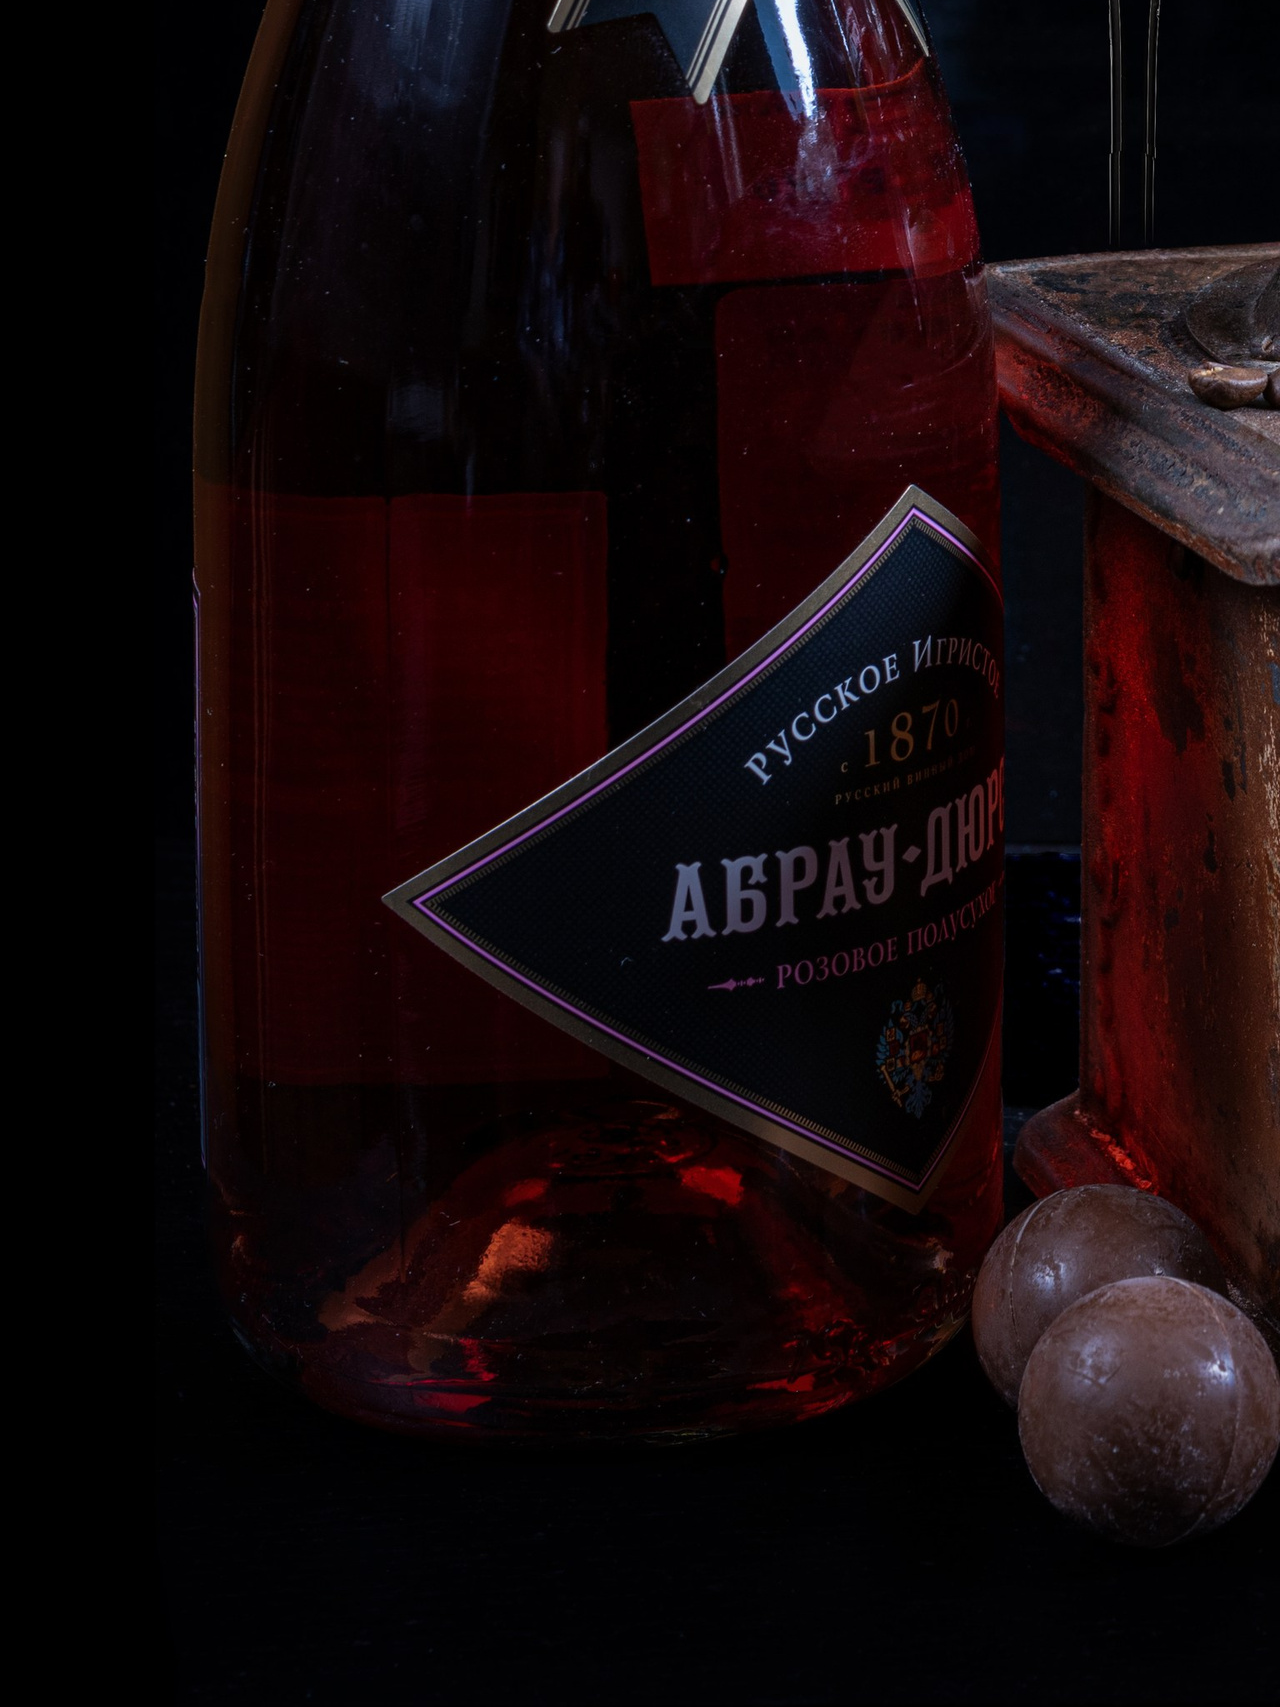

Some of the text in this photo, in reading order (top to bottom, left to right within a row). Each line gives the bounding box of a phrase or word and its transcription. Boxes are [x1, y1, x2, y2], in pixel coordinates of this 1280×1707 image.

[743, 652, 901, 786] РУССКОЕ
[864, 697, 960, 769] 1870
[833, 775, 901, 806] РУССКИЙ
[775, 935, 900, 991] РОЗОВОЕ
